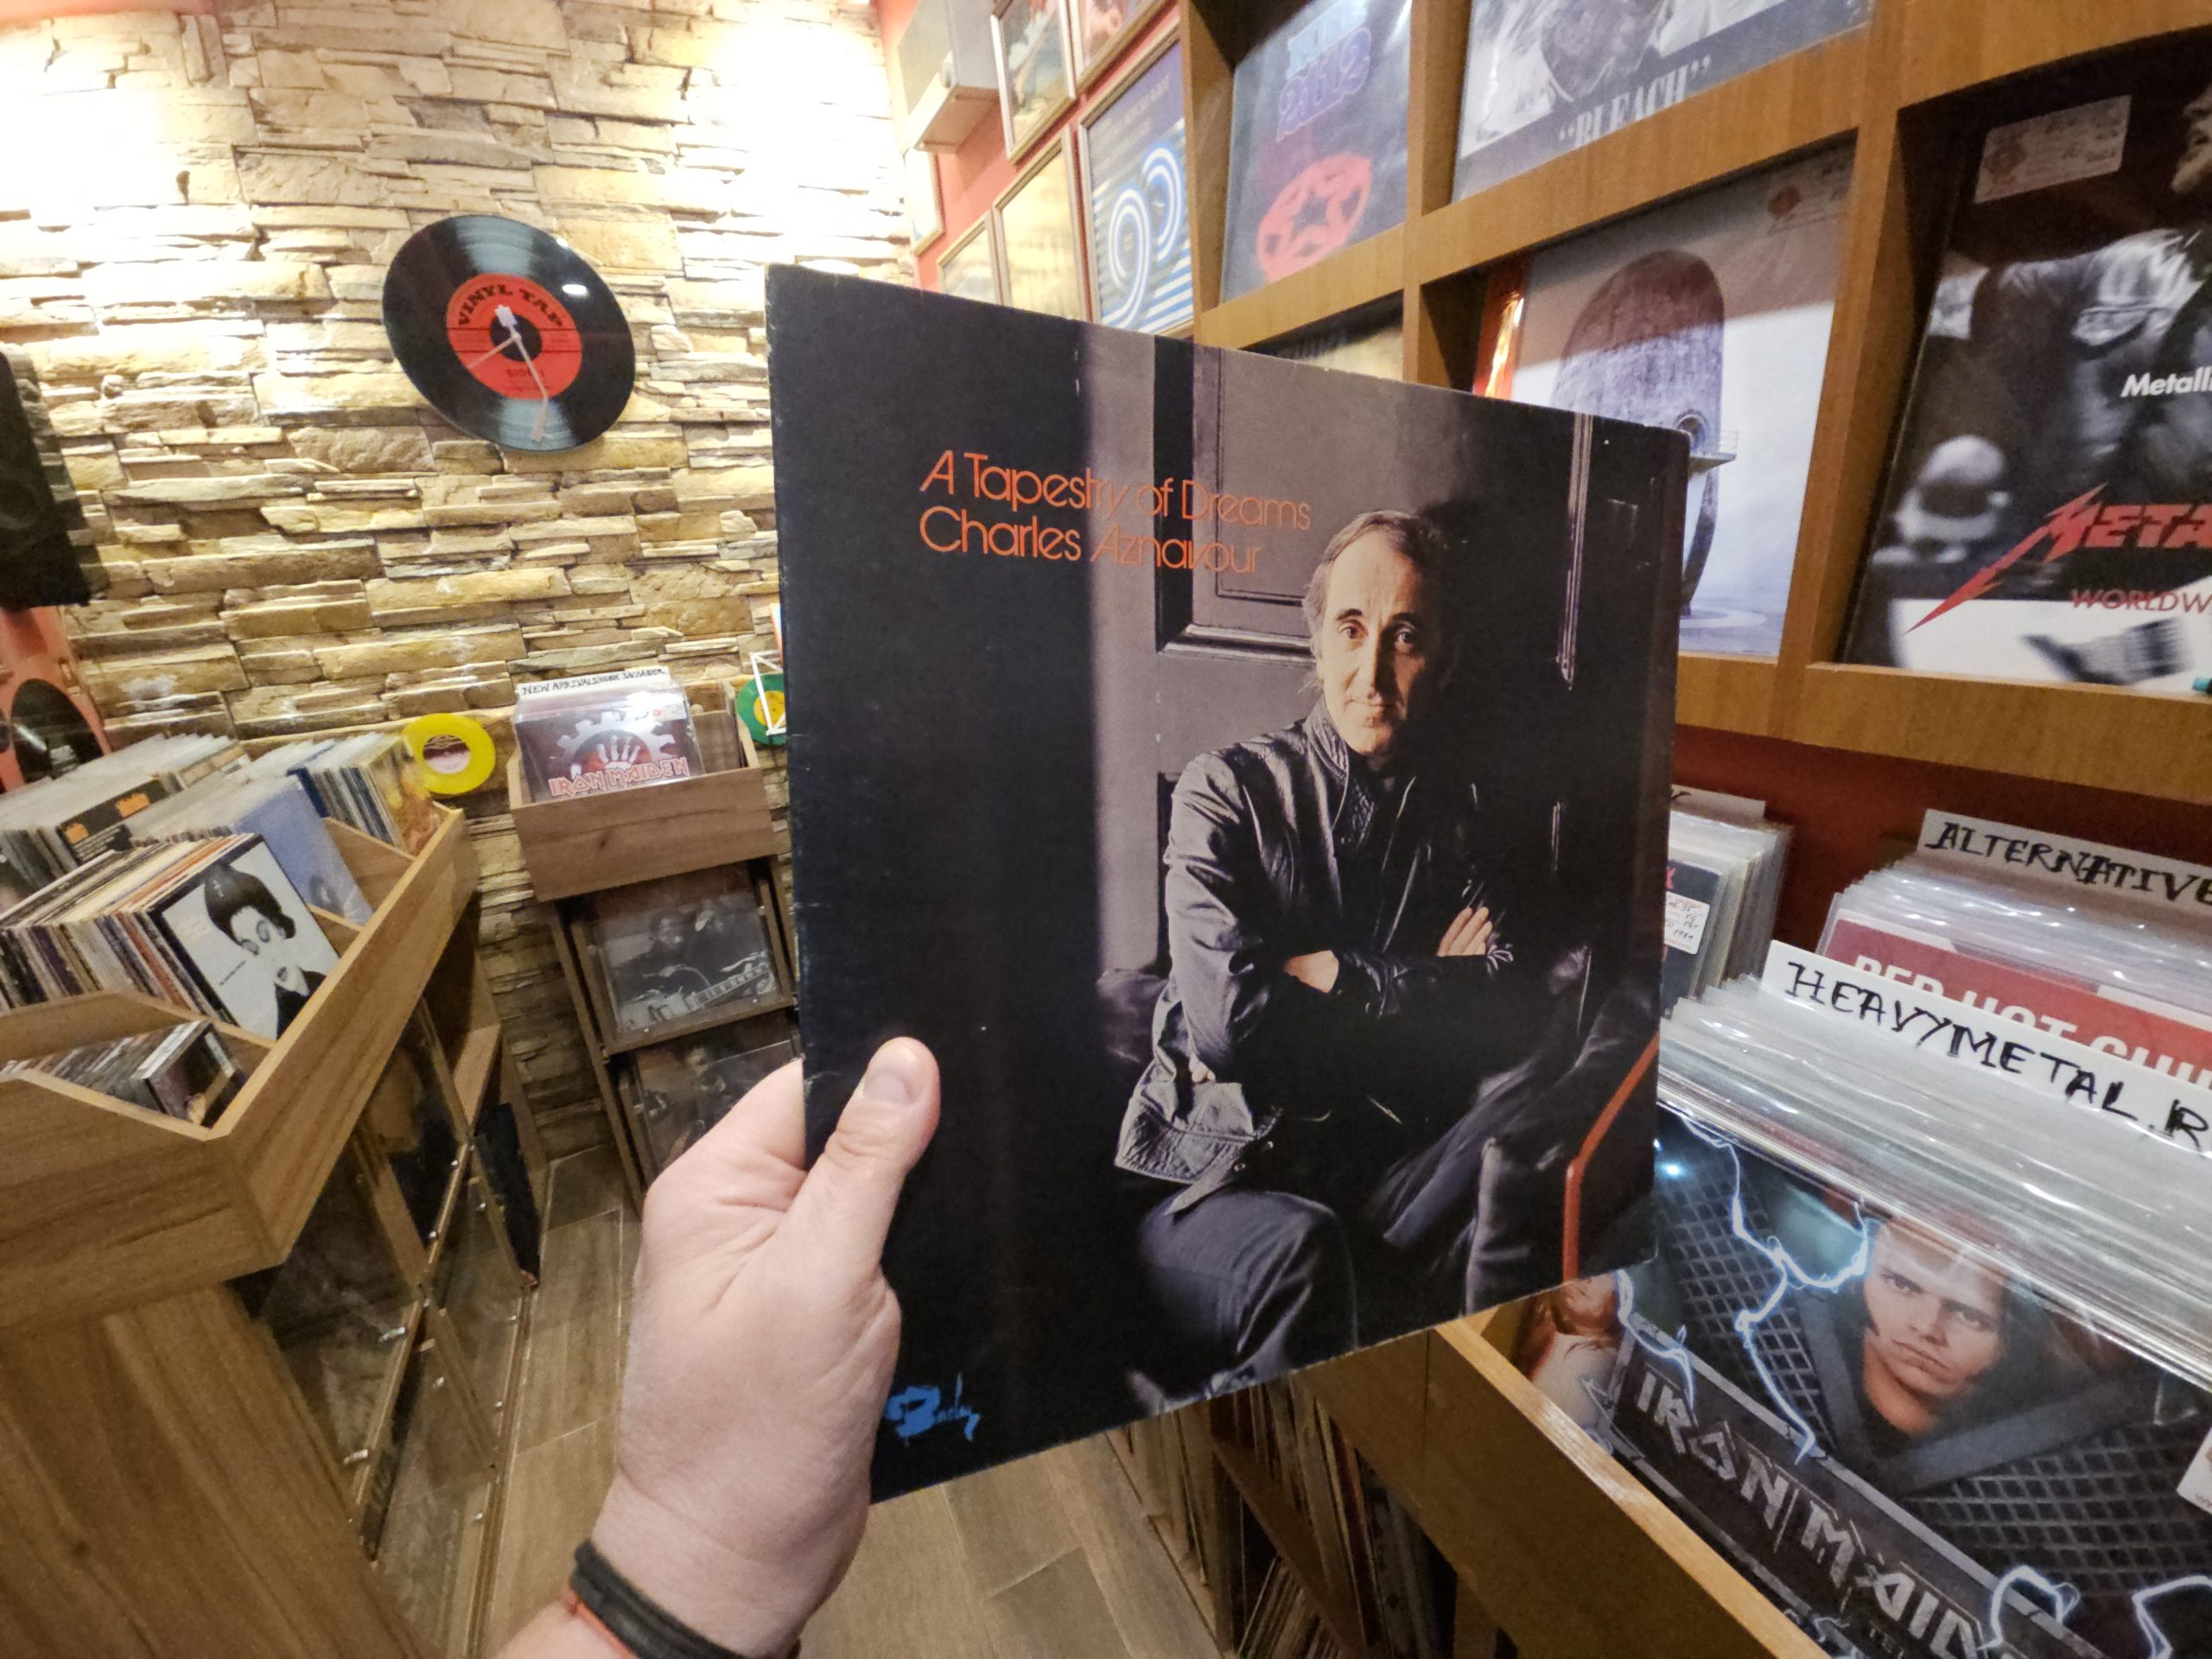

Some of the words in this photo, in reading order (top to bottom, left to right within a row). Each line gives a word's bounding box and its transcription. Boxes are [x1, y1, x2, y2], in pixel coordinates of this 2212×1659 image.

[459, 284, 514, 327] VINYL
[518, 288, 563, 327] TAP
[919, 449, 954, 495] A
[963, 451, 1133, 519] Tapestry
[1137, 476, 1174, 518] of
[1181, 479, 1312, 531] Dreams
[918, 505, 1082, 563] Charles
[1090, 524, 1262, 574] Aznavour
[548, 770, 607, 798] IRON
[606, 756, 690, 789] MAIDEN
[1925, 822, 2212, 906] ALTERNATIVE
[1637, 1374, 1799, 1554] IRON
[1800, 1499, 2026, 1659] MAID
